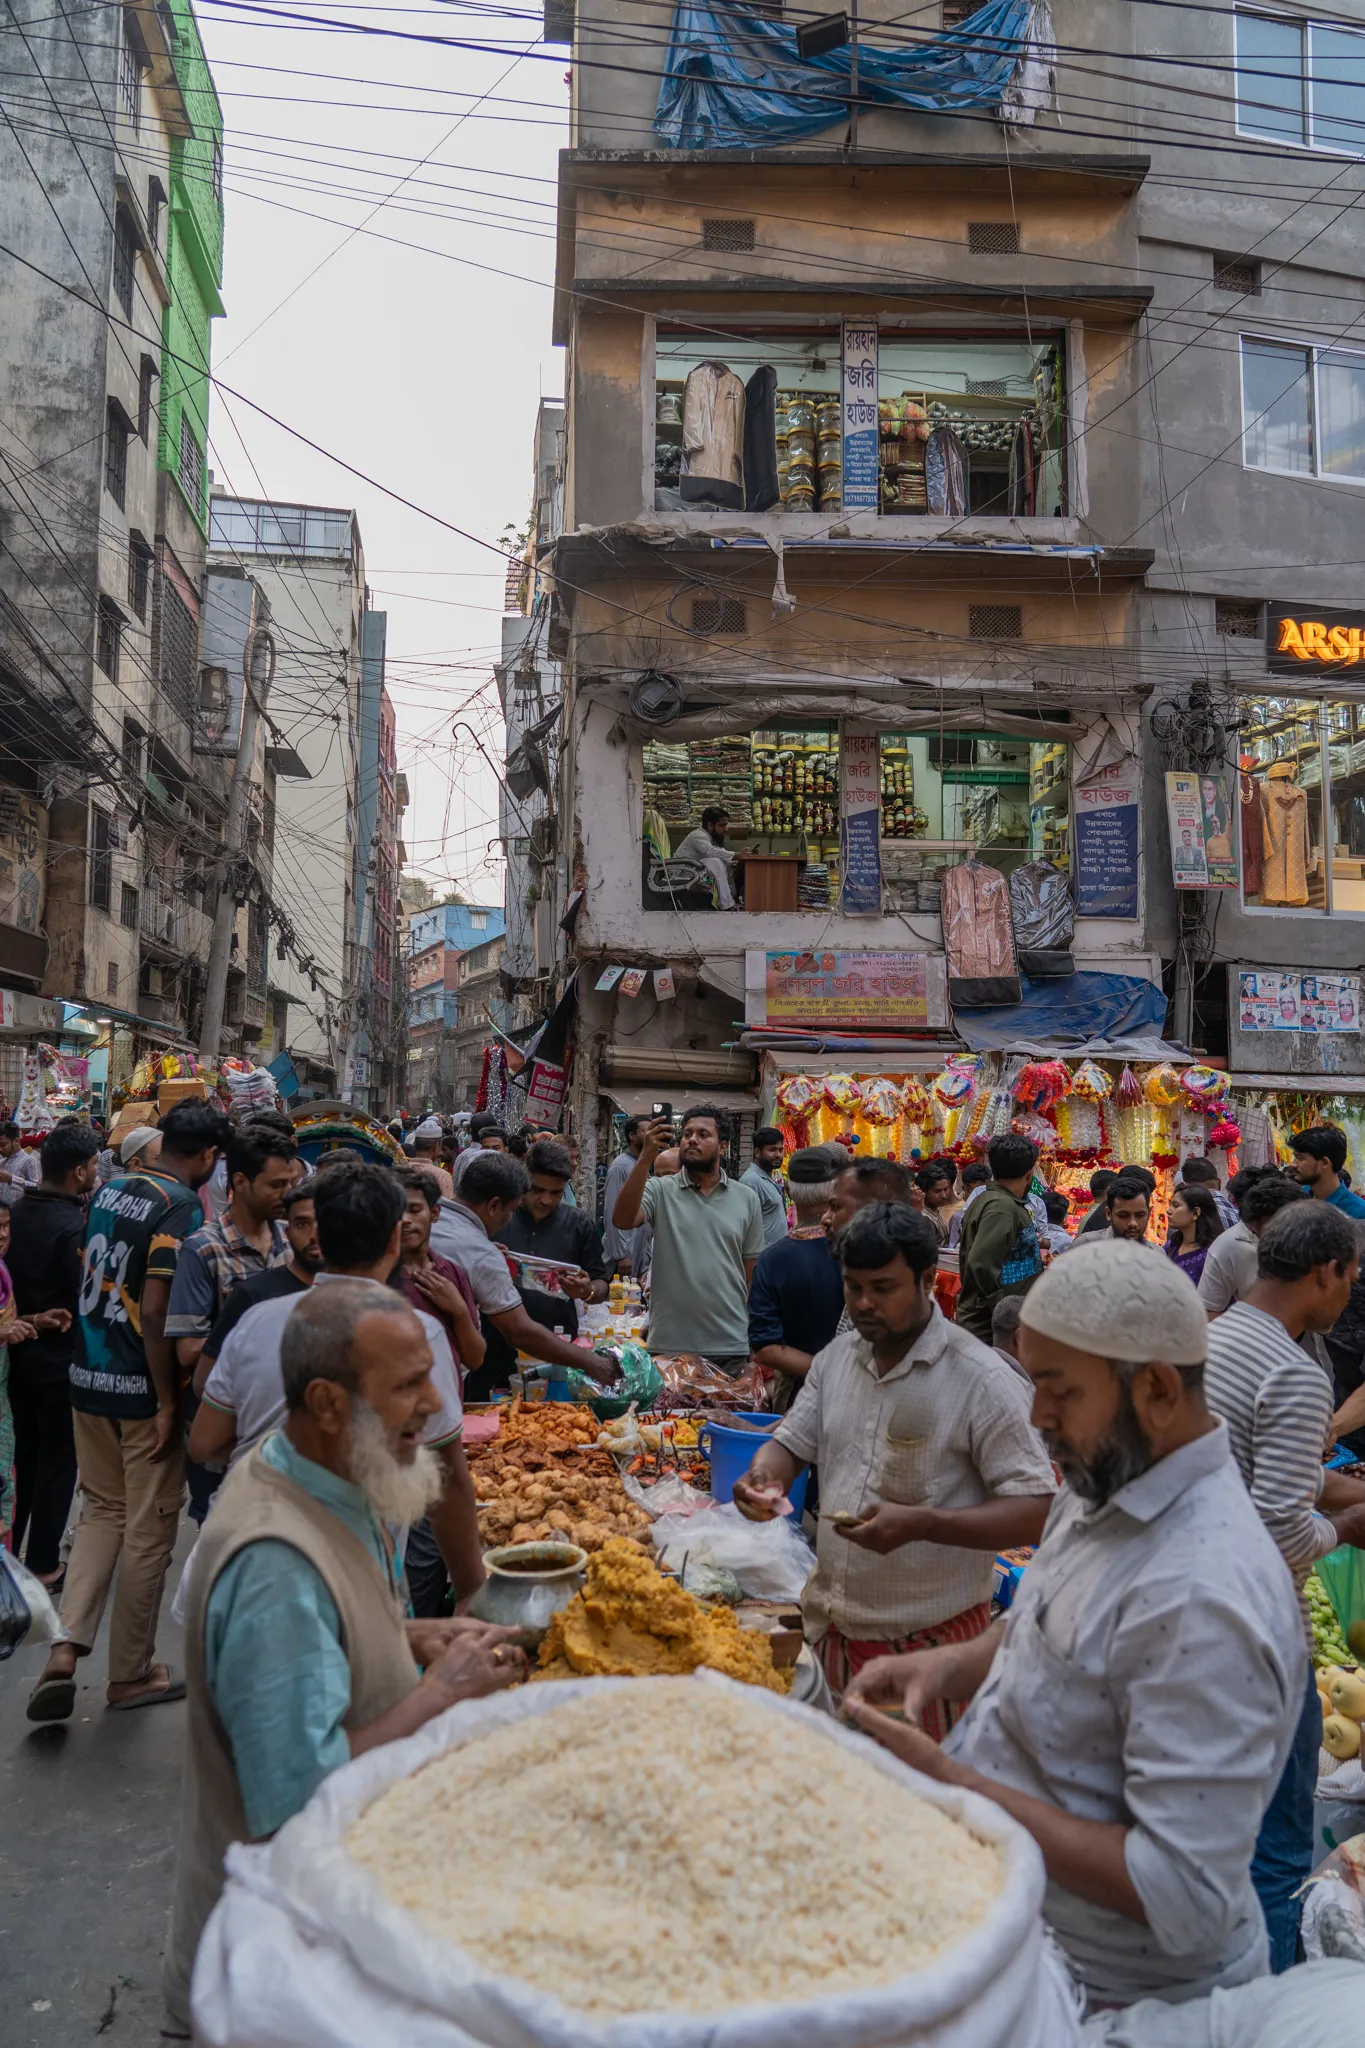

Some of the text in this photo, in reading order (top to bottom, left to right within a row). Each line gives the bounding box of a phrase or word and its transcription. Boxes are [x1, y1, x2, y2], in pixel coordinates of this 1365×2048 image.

[846, 329, 876, 352] রায়হান
[846, 358, 875, 388] জরি
[846, 395, 876, 426] হাউজ
[844, 734, 877, 755] রায়হান
[847, 760, 871, 778] জরি
[846, 786, 878, 805] হাউজ
[1079, 786, 1131, 804] হাউজ
[1084, 819, 1122, 827] উন্নতমানের
[1094, 811, 1117, 819] এখানে
[777, 973, 918, 995] বুলবুল জরি হাউজ
[92, 1371, 116, 1392] TARUN
[115, 1375, 148, 1394] SANGHA
